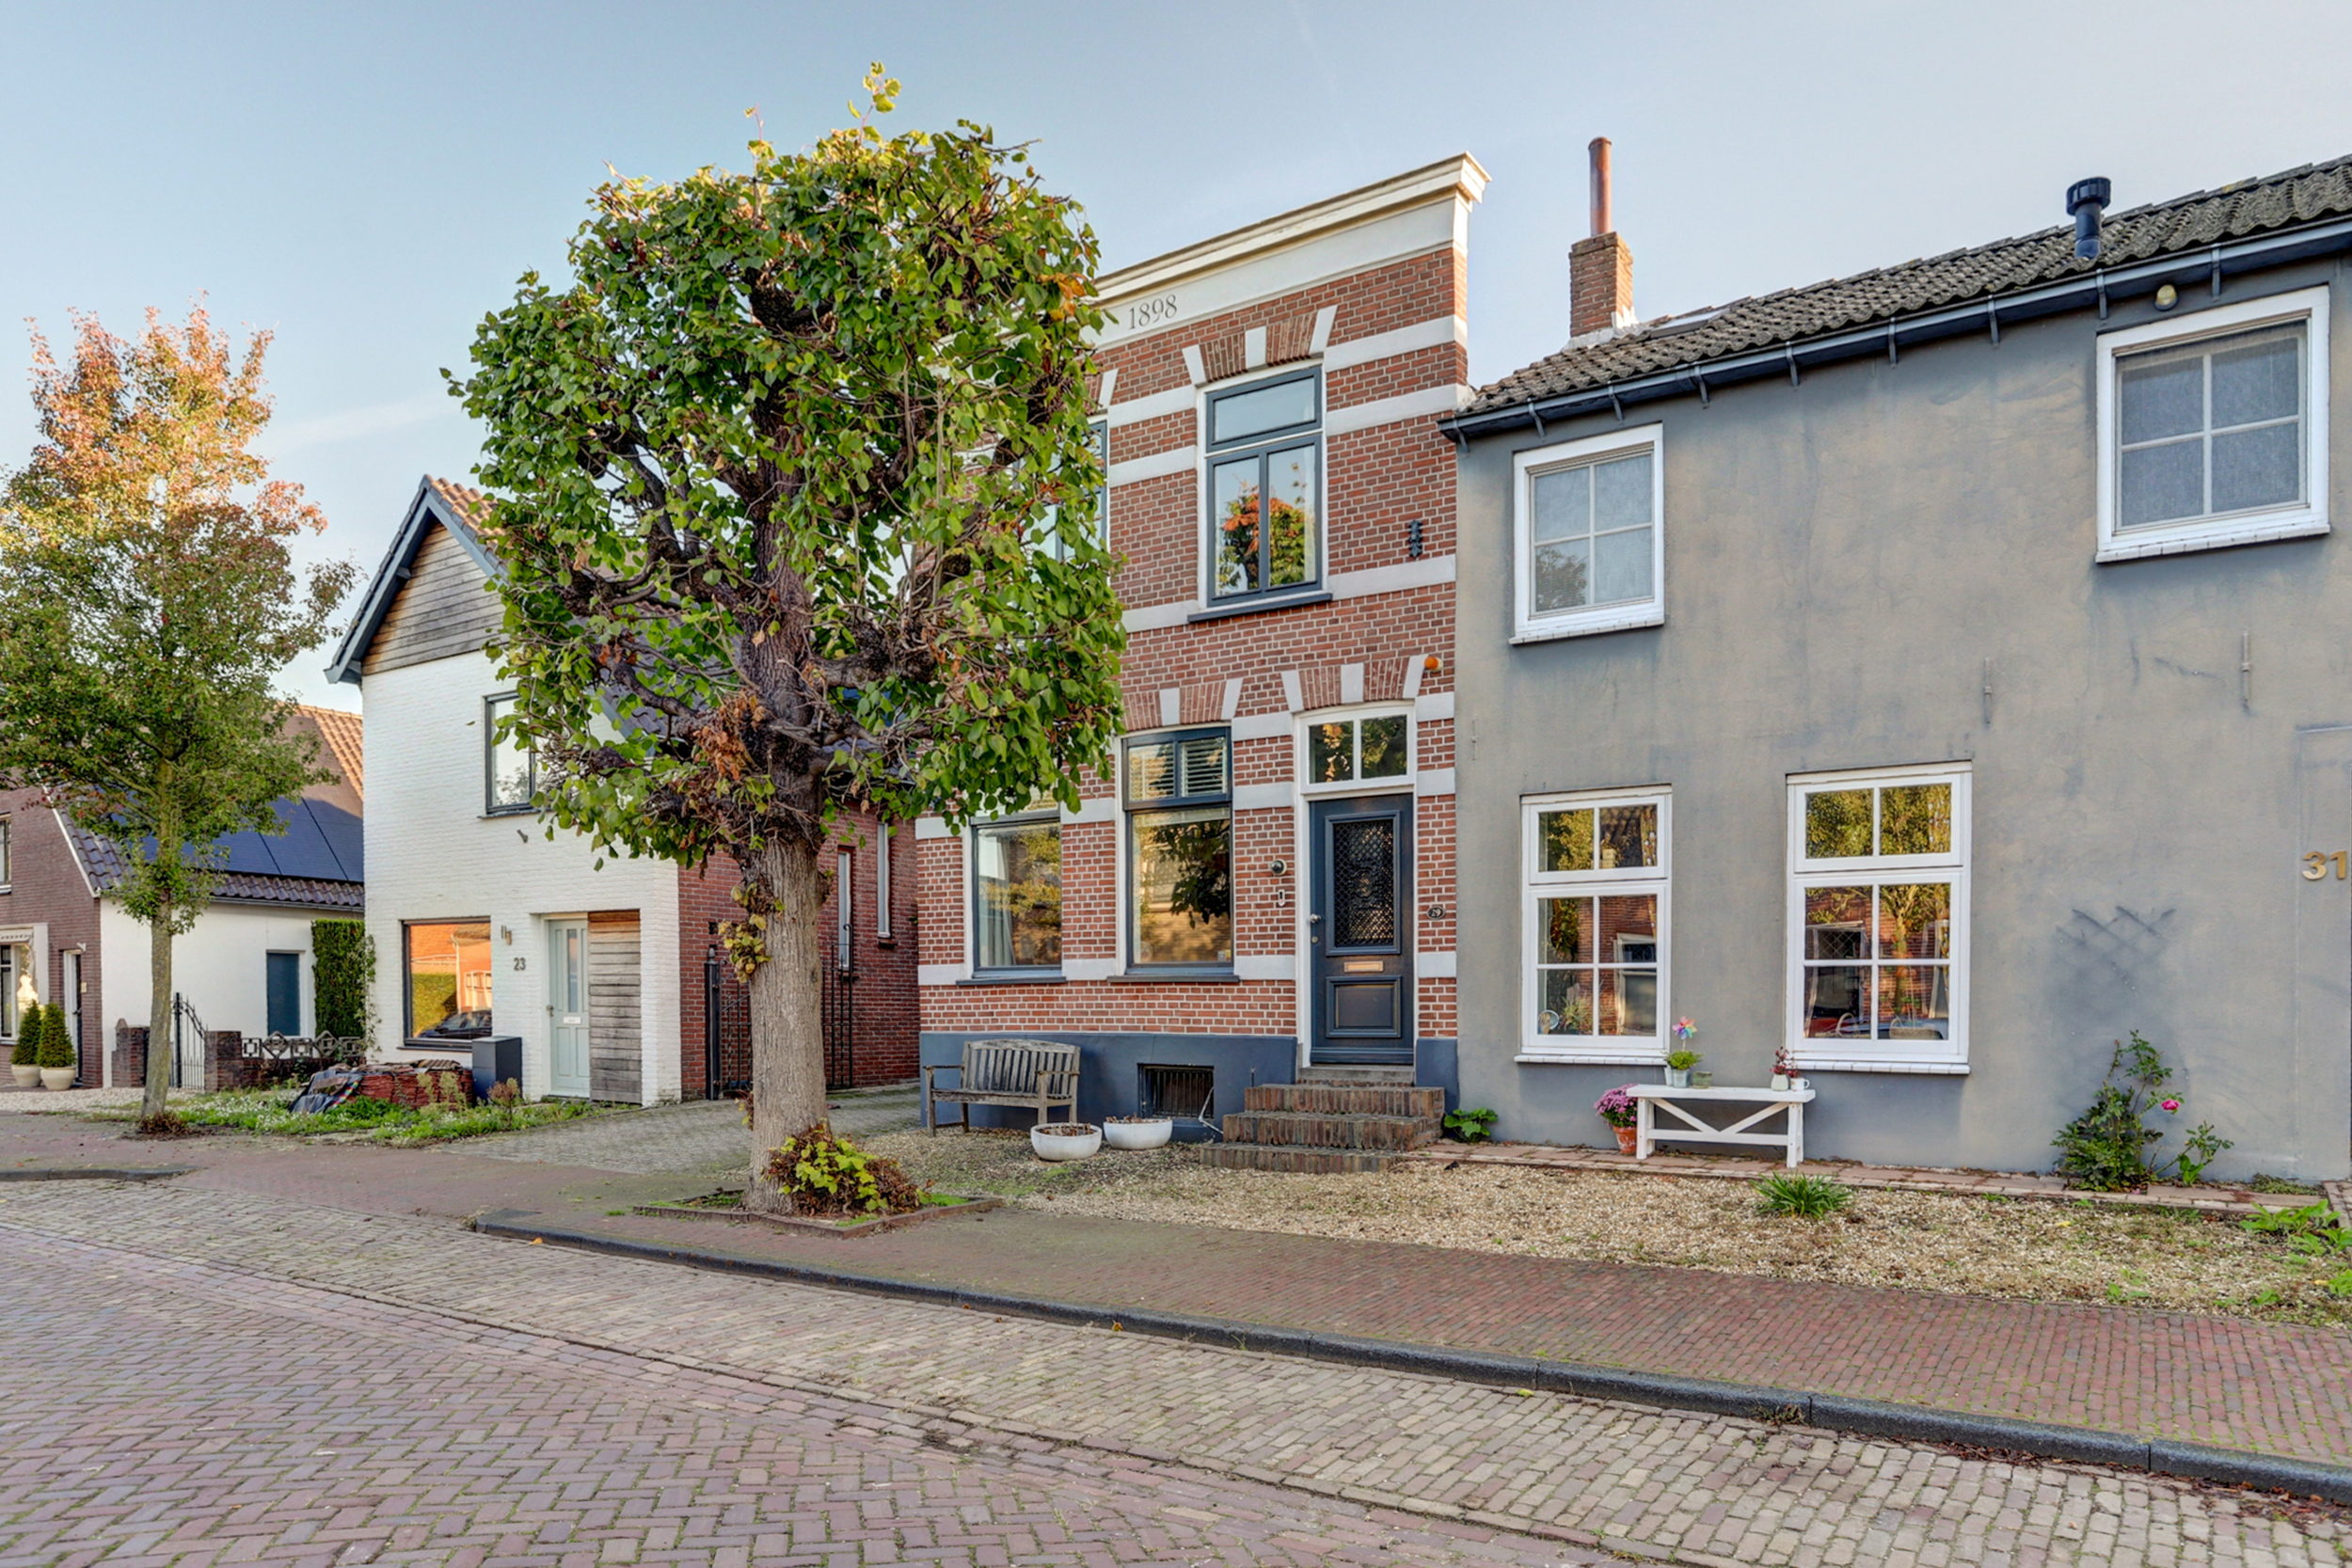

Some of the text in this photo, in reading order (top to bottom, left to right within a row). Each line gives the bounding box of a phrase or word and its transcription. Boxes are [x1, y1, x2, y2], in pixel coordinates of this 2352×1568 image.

[1128, 293, 1178, 330] 1898
[2302, 849, 2347, 880] 31
[1430, 908, 1441, 917] 29
[514, 957, 526, 971] 23
